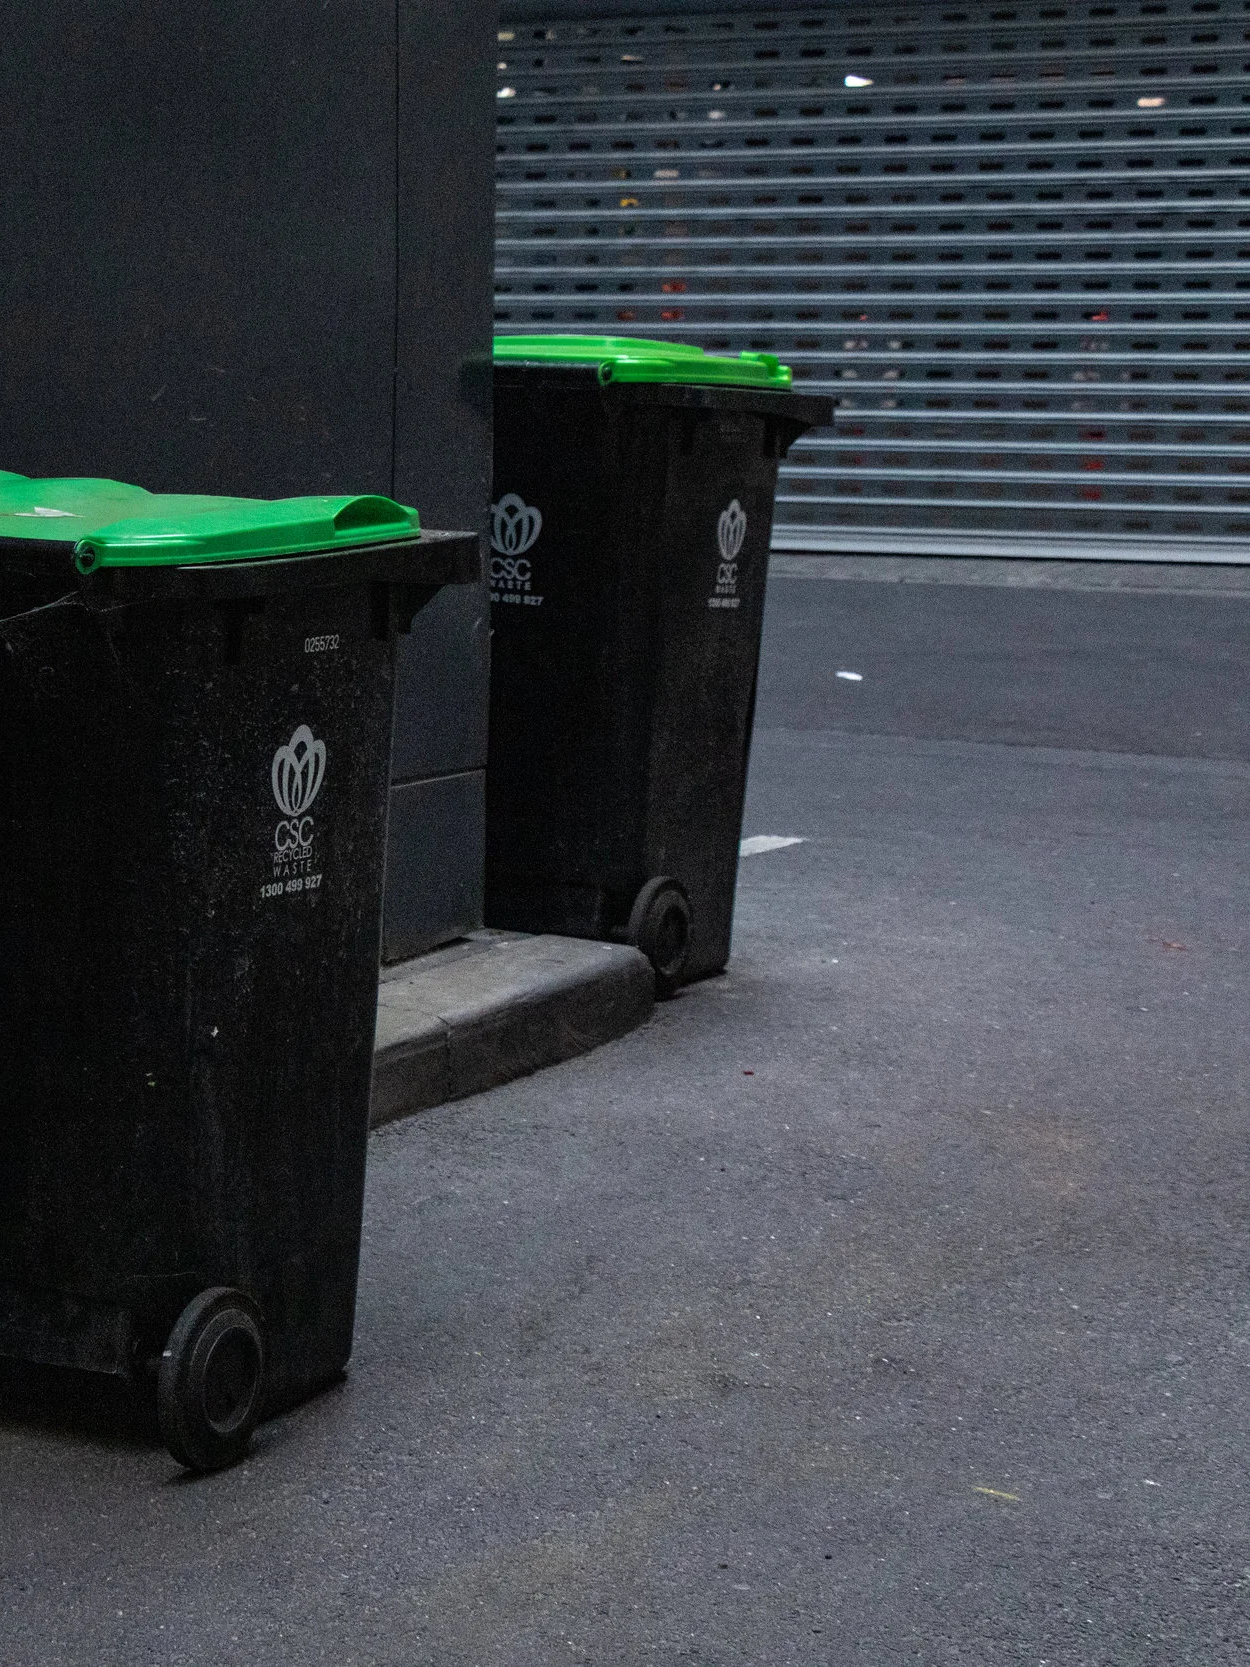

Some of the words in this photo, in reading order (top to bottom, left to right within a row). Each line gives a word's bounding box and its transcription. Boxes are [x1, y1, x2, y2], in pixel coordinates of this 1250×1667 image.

[490, 557, 532, 580] CSC
[304, 634, 340, 653] 0255732
[275, 816, 314, 851] CSC
[273, 846, 313, 863] RECYCLED
[273, 859, 312, 877] WASTE
[260, 882, 283, 898] 1300
[285, 878, 303, 893] 499
[305, 873, 323, 889] 927
